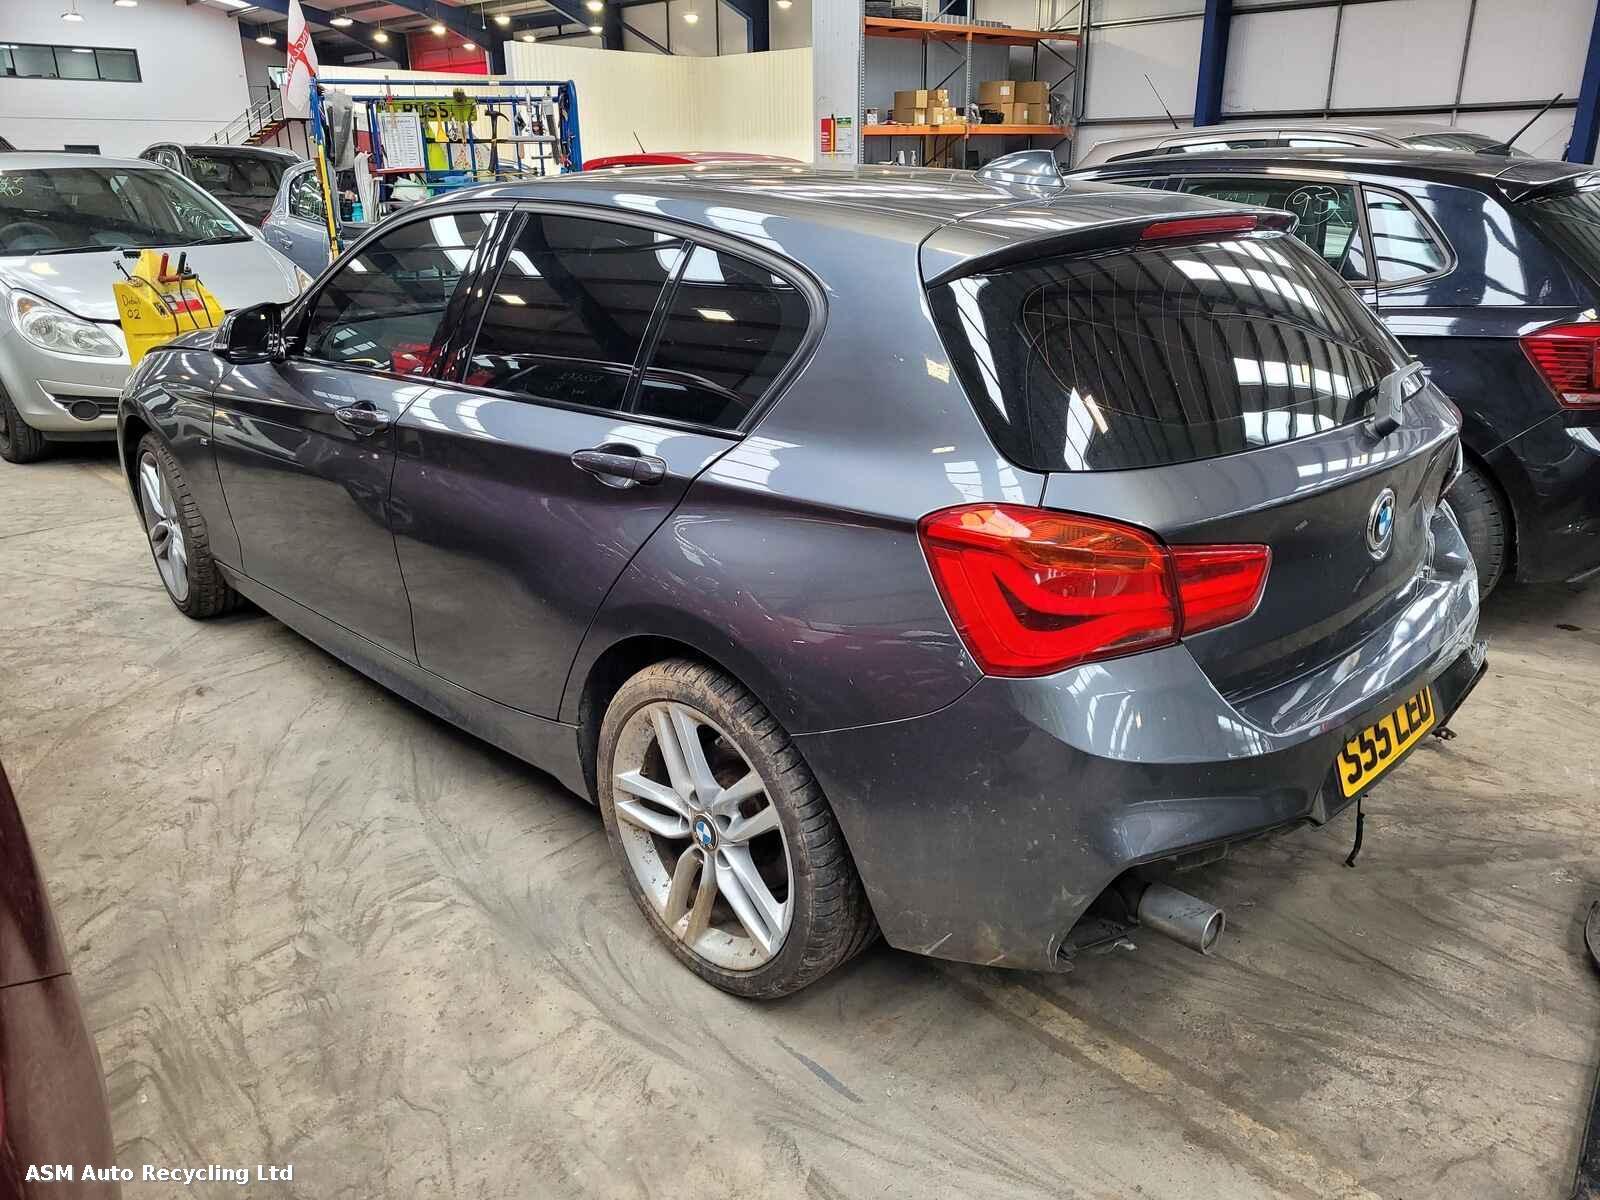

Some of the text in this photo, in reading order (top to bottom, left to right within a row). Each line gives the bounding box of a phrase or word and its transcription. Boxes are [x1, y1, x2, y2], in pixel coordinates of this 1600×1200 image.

[1293, 192, 1331, 217] 95
[127, 308, 141, 320] 02
[1342, 721, 1392, 784] S55
